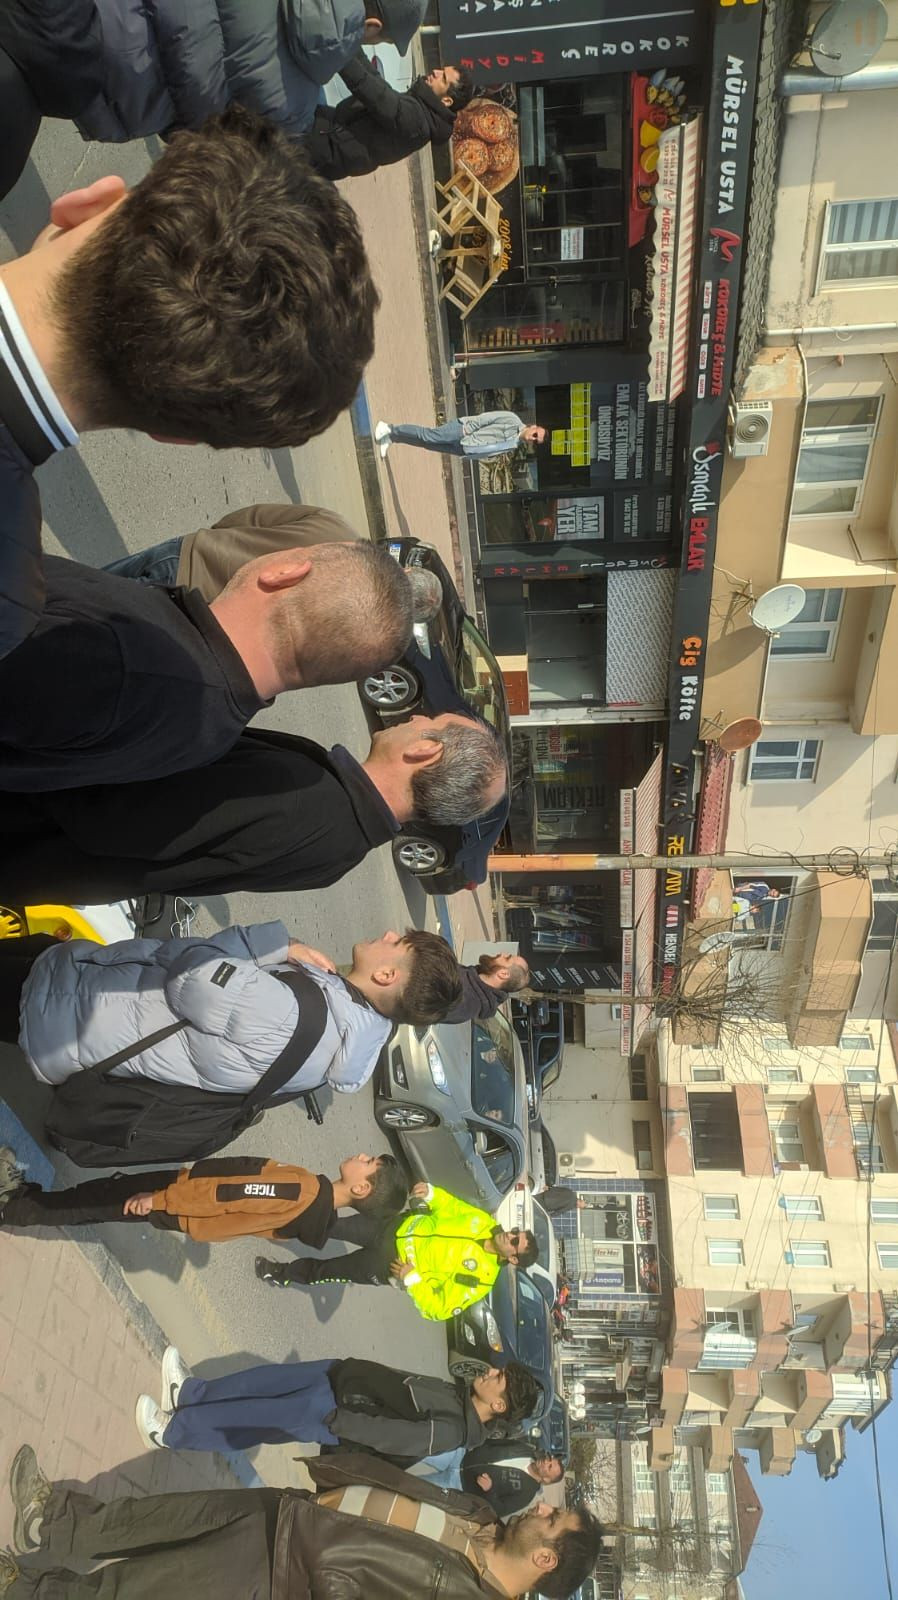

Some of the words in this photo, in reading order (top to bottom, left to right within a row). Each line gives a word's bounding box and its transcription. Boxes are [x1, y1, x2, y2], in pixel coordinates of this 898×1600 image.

[460, 50, 544, 69] MİDYE
[560, 34, 690, 59] KOKOREÇ
[721, 54, 747, 153] MÜRSEL
[718, 160, 736, 214] USTA
[661, 207, 673, 249] MÜRSEL
[659, 251, 671, 275] USTA
[657, 278, 667, 311] KOKOREÇ
[710, 278, 730, 343] KOKOREÇ
[712, 344, 726, 353] &
[616, 384, 630, 418] EMLAK
[597, 405, 614, 462] ÖNCÜSÜYÜZ
[614, 420, 630, 480] SEKTÖRÜNÜN
[556, 506, 576, 535] YER
[582, 504, 600, 533] TAM
[687, 517, 710, 571] EMLAK
[679, 676, 699, 720] Köfte
[623, 839, 632, 854] ANK
[665, 835, 685, 896] REAM
[663, 933, 678, 964] HENDEK
[623, 972, 632, 995] HENDEK
[244, 1184, 276, 1197] TIGER
